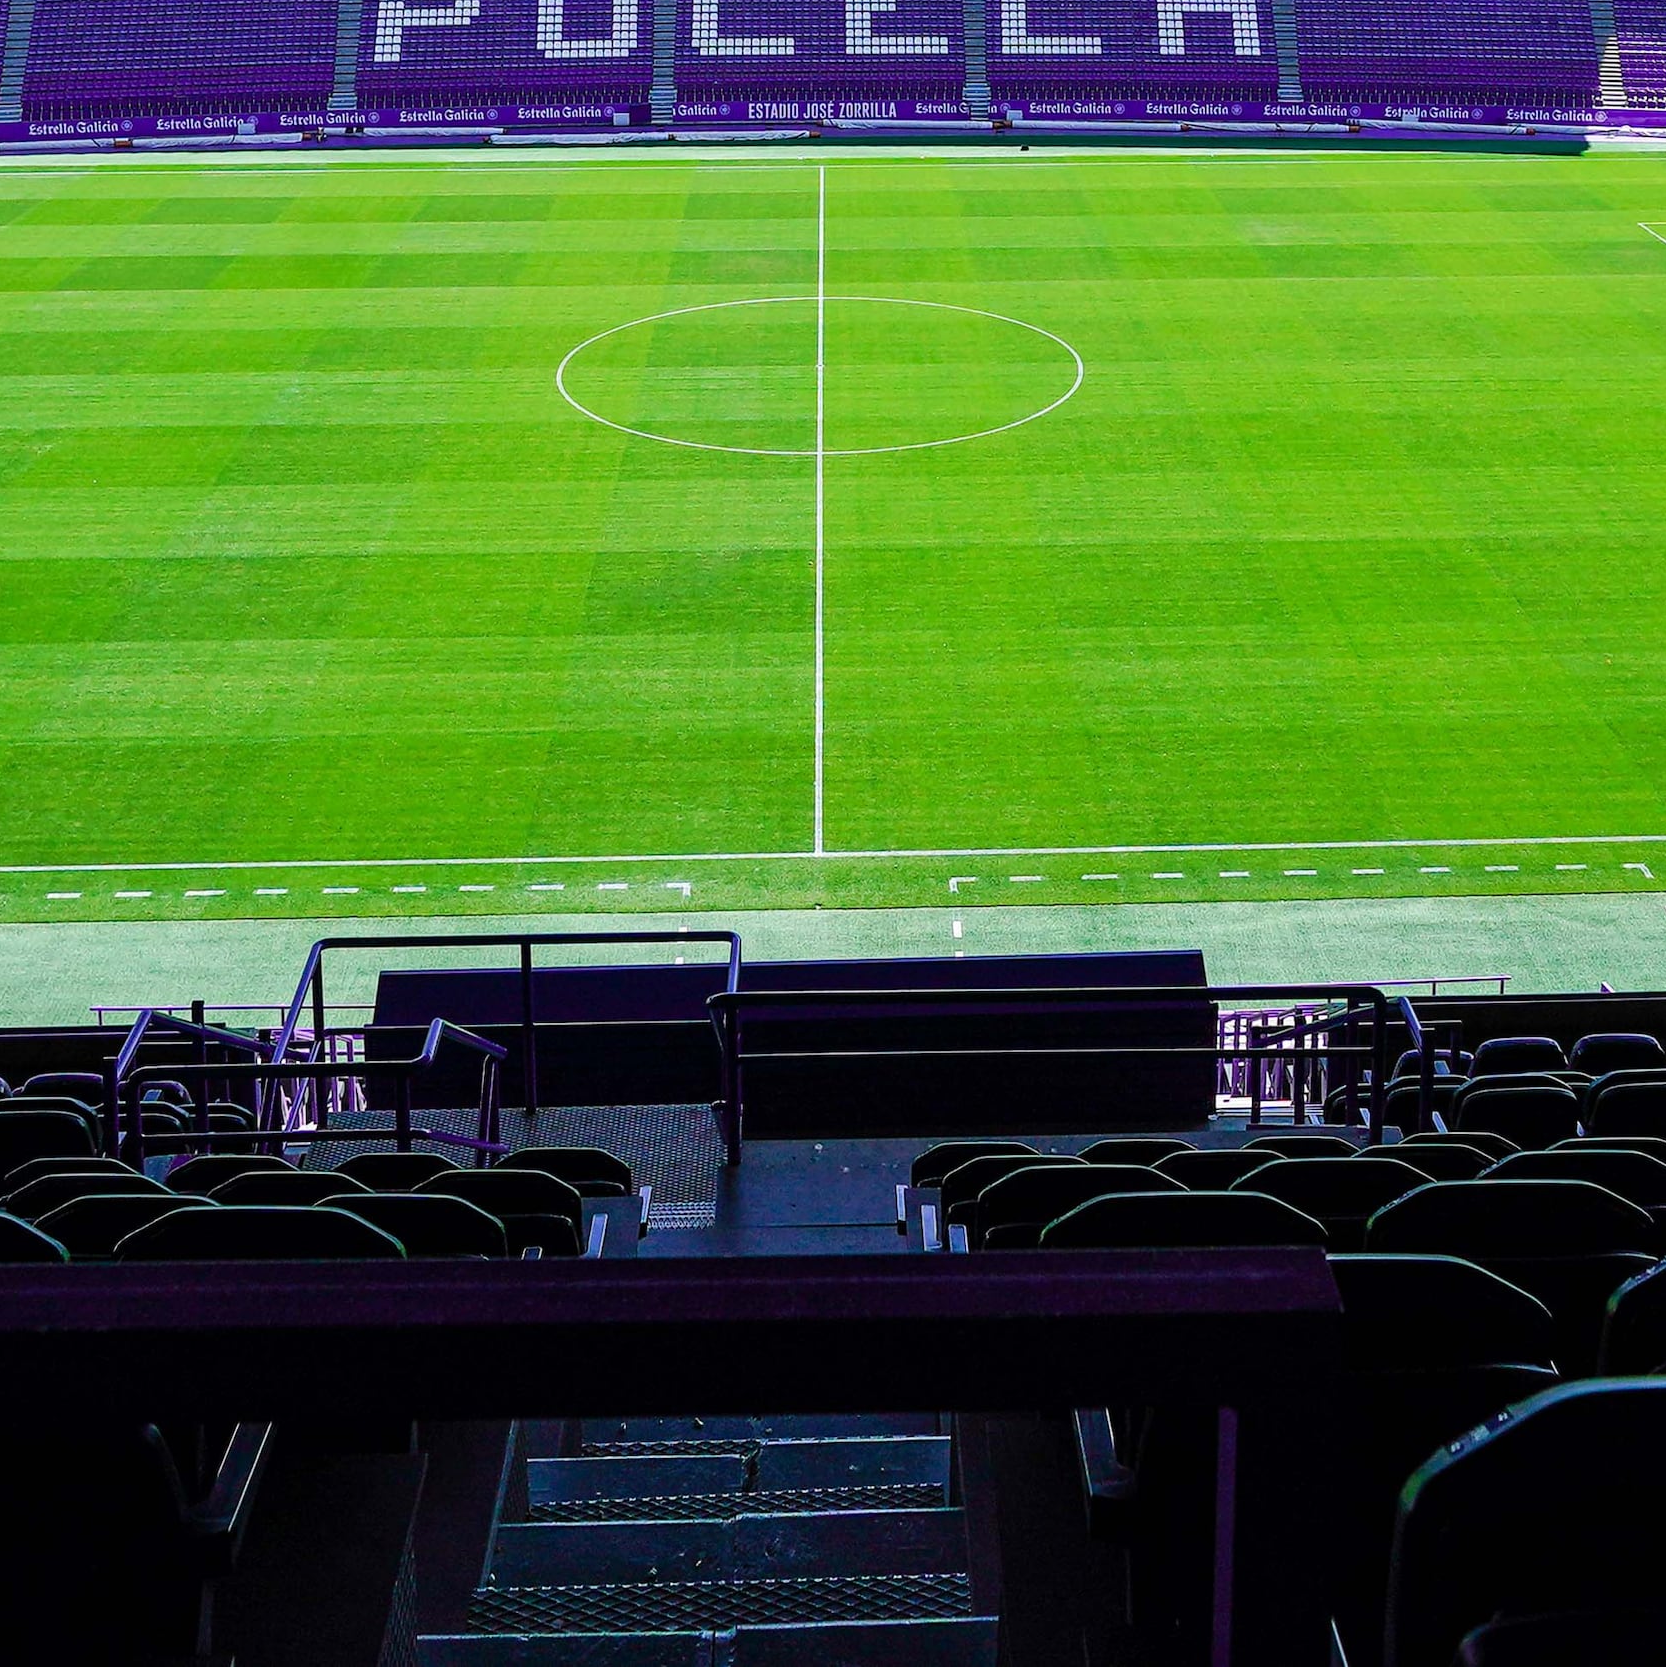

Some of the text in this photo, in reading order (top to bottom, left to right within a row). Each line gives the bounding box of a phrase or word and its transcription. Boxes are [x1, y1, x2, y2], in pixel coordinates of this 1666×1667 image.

[399, 108, 484, 121] Estrella Galicia
[518, 106, 601, 119] Estrella Galicia
[678, 104, 717, 116] Galicia
[748, 100, 897, 119] ESTADIO JOSÉ ZORRILLA
[915, 102, 957, 114] Estrella
[1029, 102, 1112, 114] Estrella Galicia
[1145, 103, 1229, 115] Estrella Galicia
[1263, 104, 1347, 116] Estrella Galicia
[1429, 106, 1469, 118] Galicia
[280, 112, 366, 126] Estrella Galicia
[1505, 108, 1592, 122] Estrella Galicia
[28, 120, 118, 135] Estrella Galicia
[156, 116, 244, 130] Estrella Galicia
